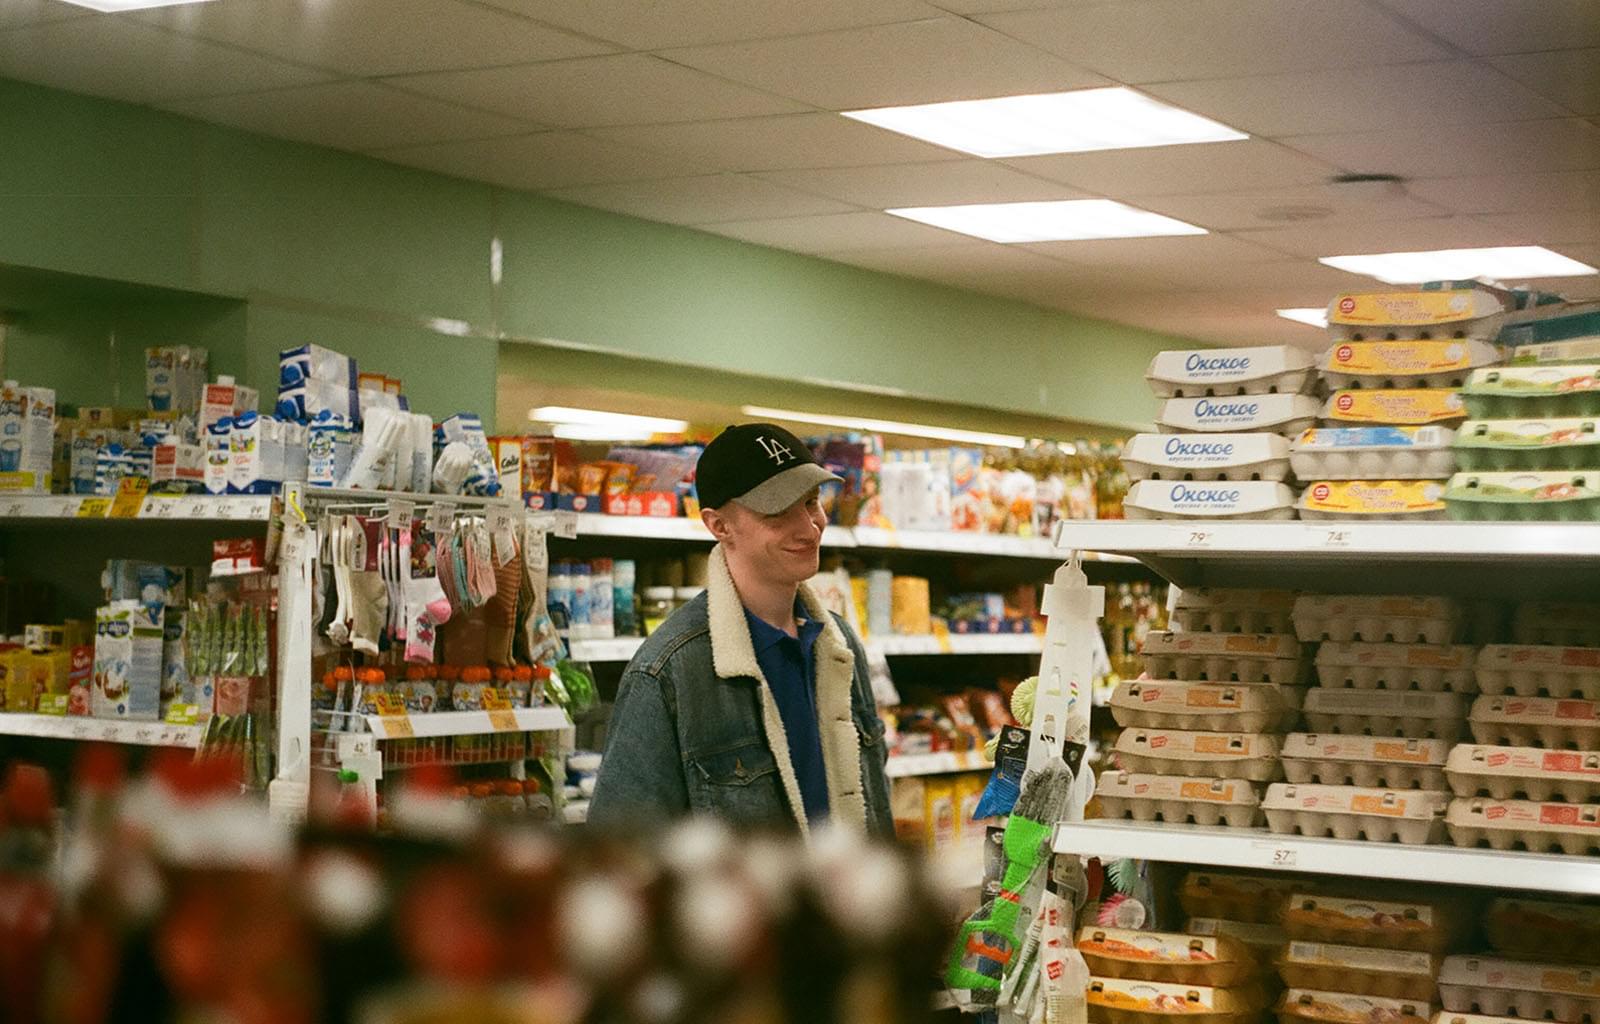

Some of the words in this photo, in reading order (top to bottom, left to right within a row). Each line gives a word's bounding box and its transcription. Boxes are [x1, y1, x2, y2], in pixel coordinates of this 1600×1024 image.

[1185, 353, 1250, 371] Окское
[1194, 399, 1258, 417] Окское
[755, 435, 796, 466] LA
[1164, 437, 1234, 455] Окское
[1170, 484, 1240, 502] Окское
[1189, 531, 1206, 542] 79
[1327, 531, 1343, 542] 74
[1273, 849, 1290, 861] 57
